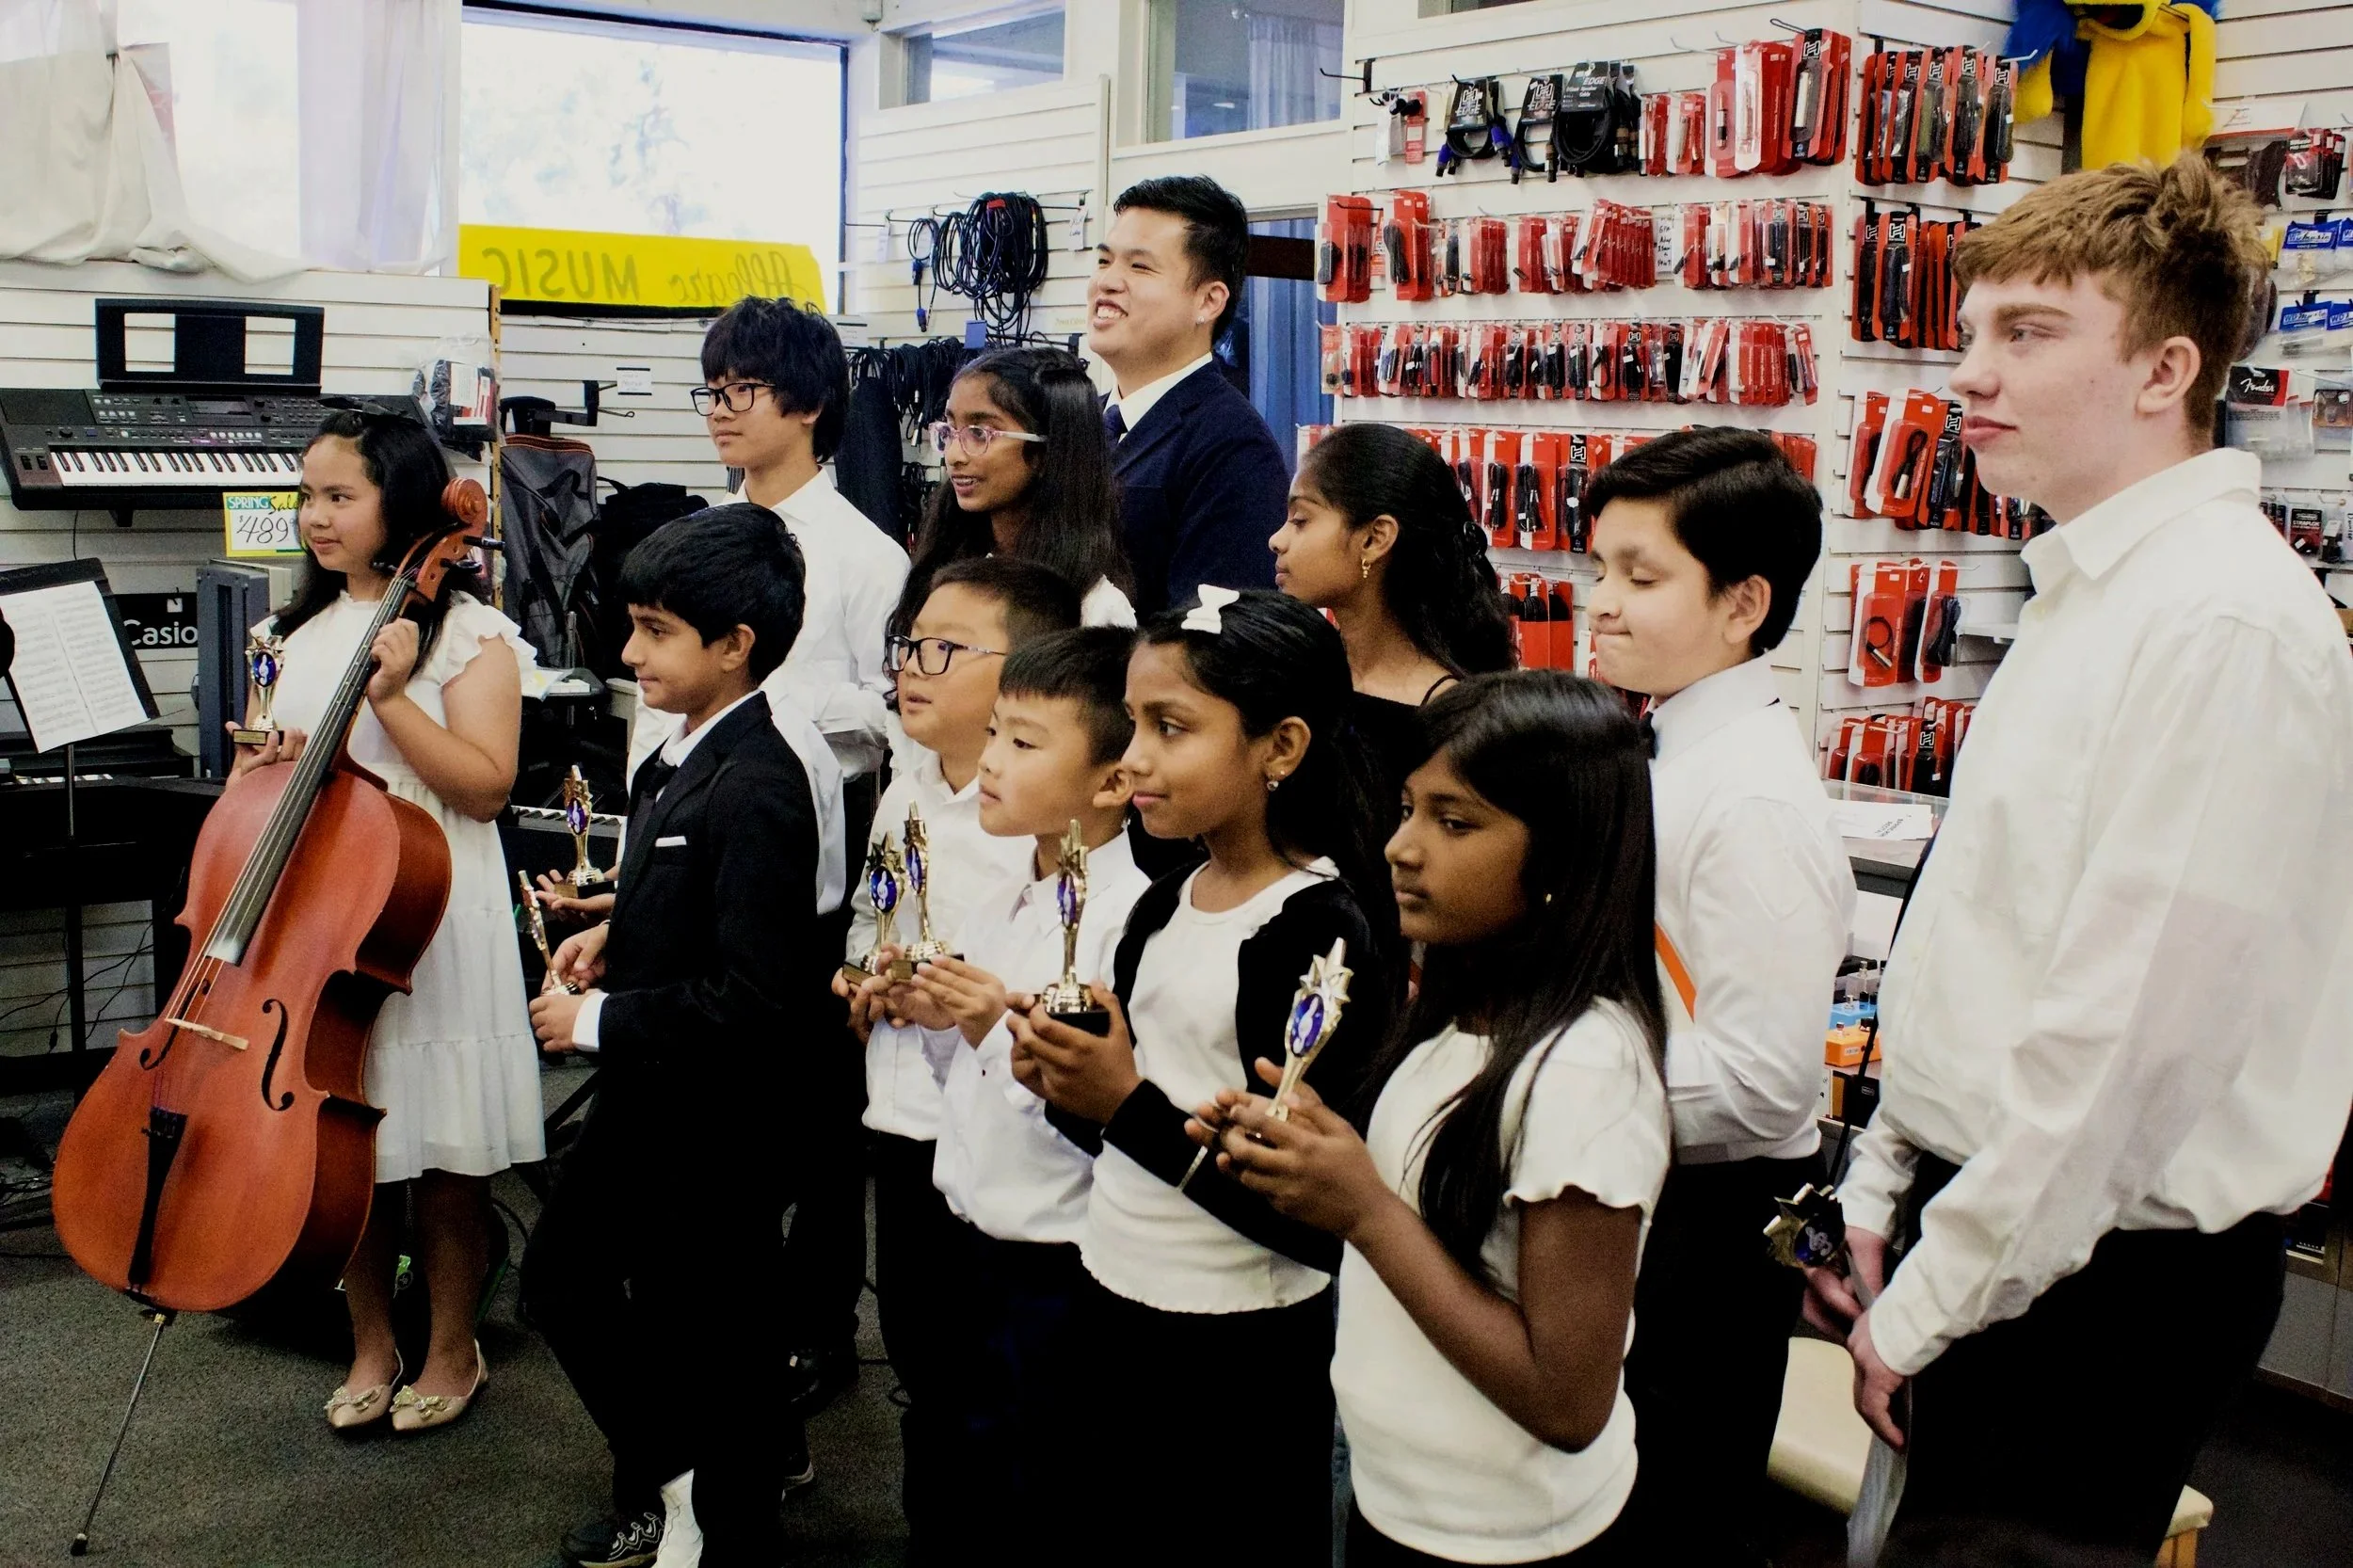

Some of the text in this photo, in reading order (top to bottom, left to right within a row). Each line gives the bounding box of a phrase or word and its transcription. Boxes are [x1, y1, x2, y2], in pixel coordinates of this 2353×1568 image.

[1583, 76, 1607, 85] EDGE
[1455, 104, 1481, 116] EDGE
[1527, 100, 1556, 111] EDGE
[2240, 378, 2275, 392] Fender
[228, 496, 269, 509] SPRING
